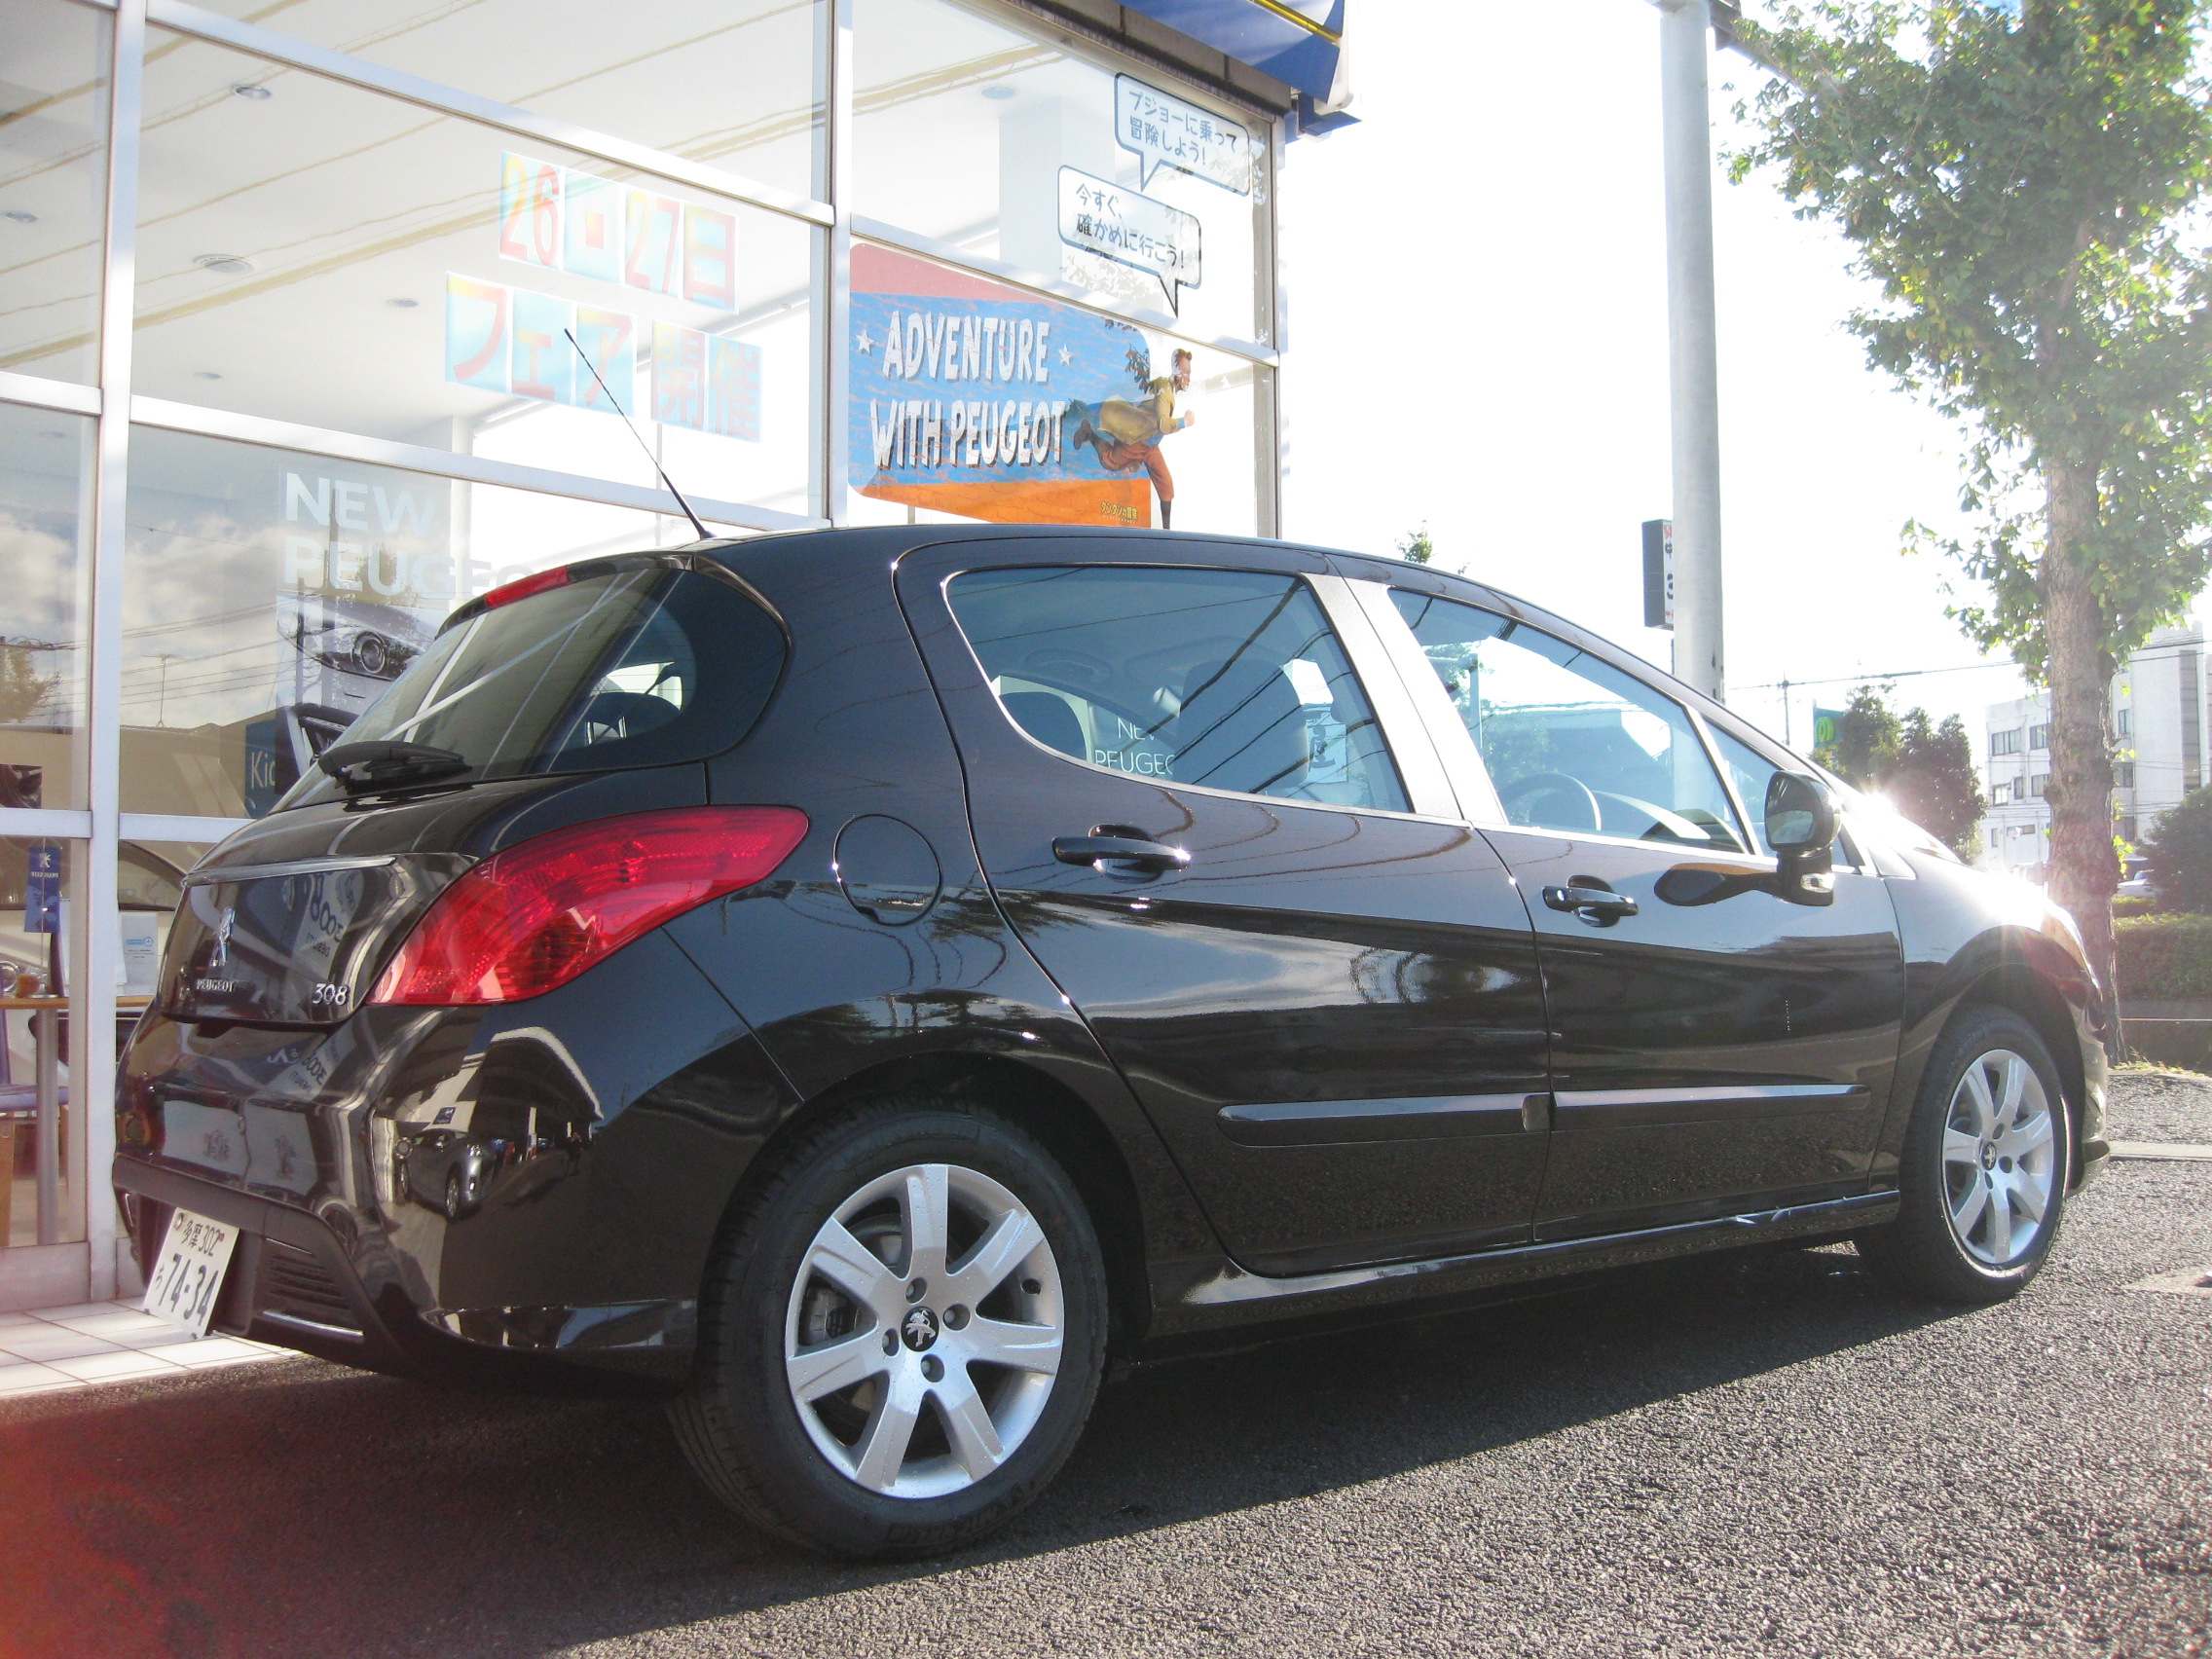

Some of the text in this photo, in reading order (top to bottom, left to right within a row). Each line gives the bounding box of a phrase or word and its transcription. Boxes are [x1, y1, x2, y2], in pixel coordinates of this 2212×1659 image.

[1129, 90, 1237, 154] プジョーに乗って
[882, 310, 1051, 384] ADVENTURE
[869, 398, 1066, 469] WITH PEUGEOT
[285, 472, 438, 536] NEW
[1117, 717, 1155, 741] NE
[196, 977, 235, 993] PEUGEOT
[312, 982, 349, 1006] 308
[158, 1252, 219, 1327] 74-34
